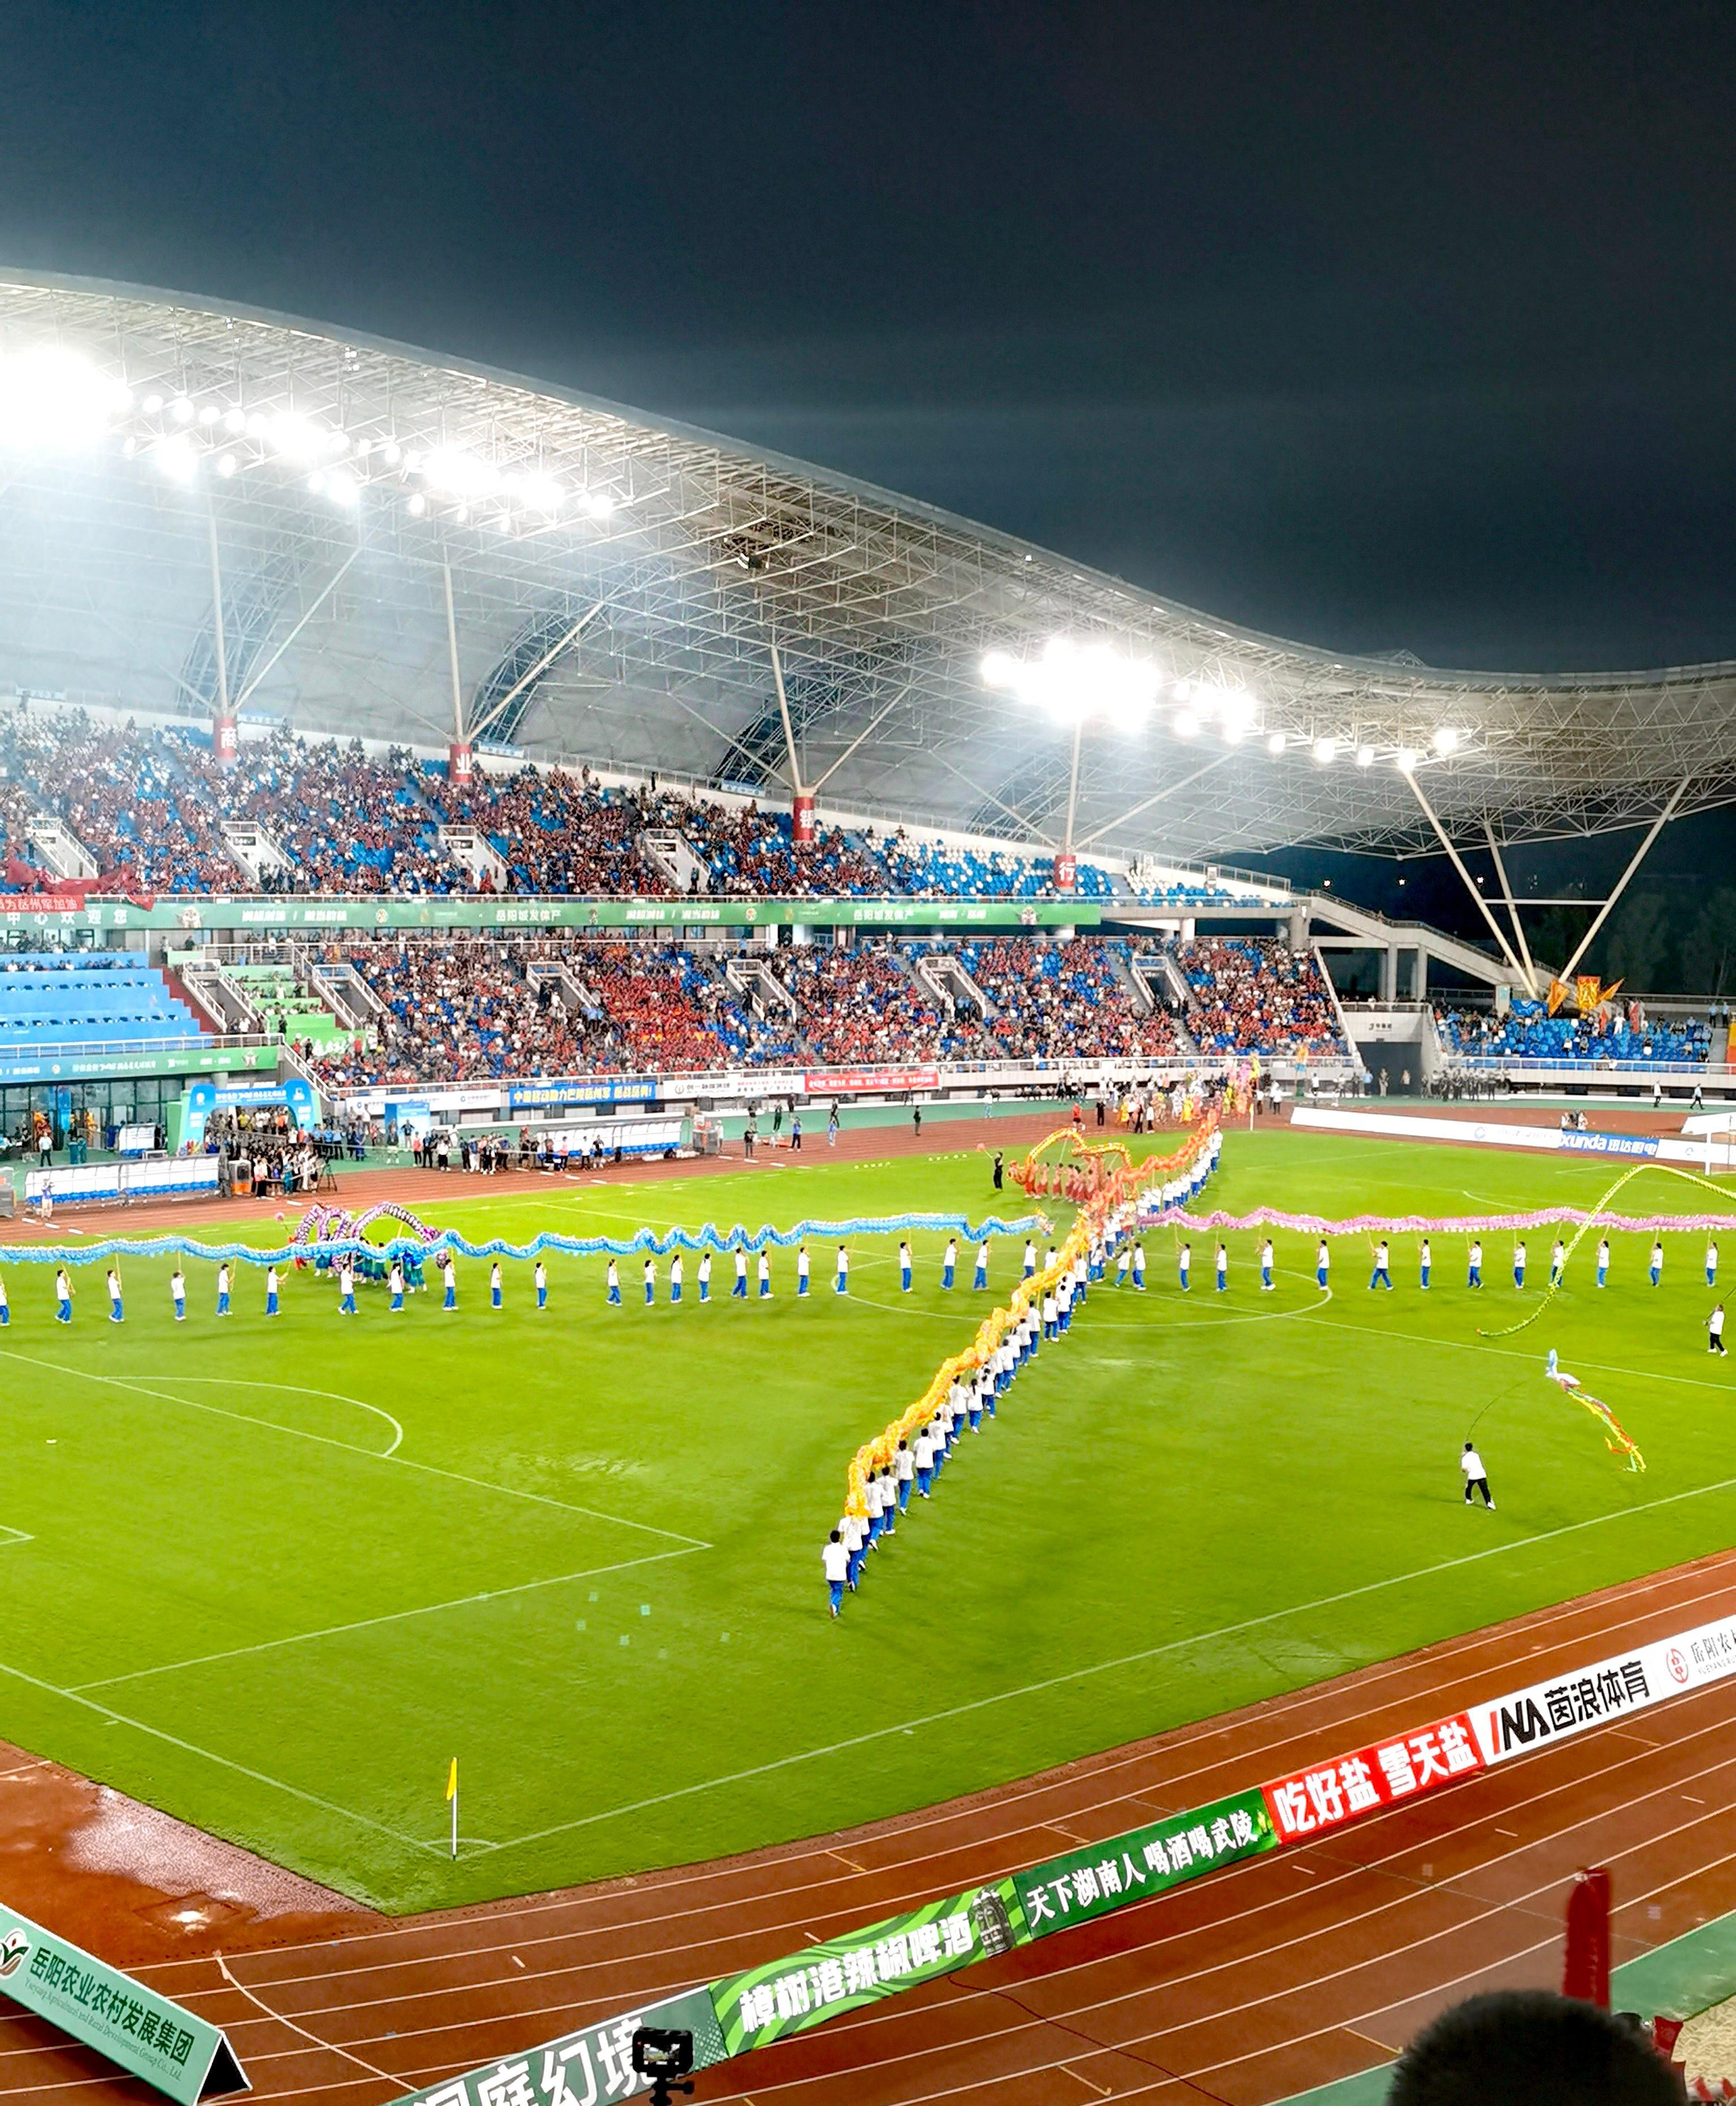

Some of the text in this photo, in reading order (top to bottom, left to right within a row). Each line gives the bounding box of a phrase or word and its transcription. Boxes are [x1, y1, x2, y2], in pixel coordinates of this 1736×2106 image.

[455, 753, 472, 774] 业
[1059, 862, 1075, 882] 行
[1690, 1629, 1736, 1664] 岳阳农
[1544, 1660, 1651, 1731] 茵浪体育
[1273, 1721, 1478, 1834] 吃好盐 雪天盐
[1026, 1809, 1258, 1928] 天下湖南人 喝酒喝武陵
[29, 1947, 196, 2067] 岳阳农业农村发展集团
[739, 1910, 974, 2034] 樟树港辣椒啤酒
